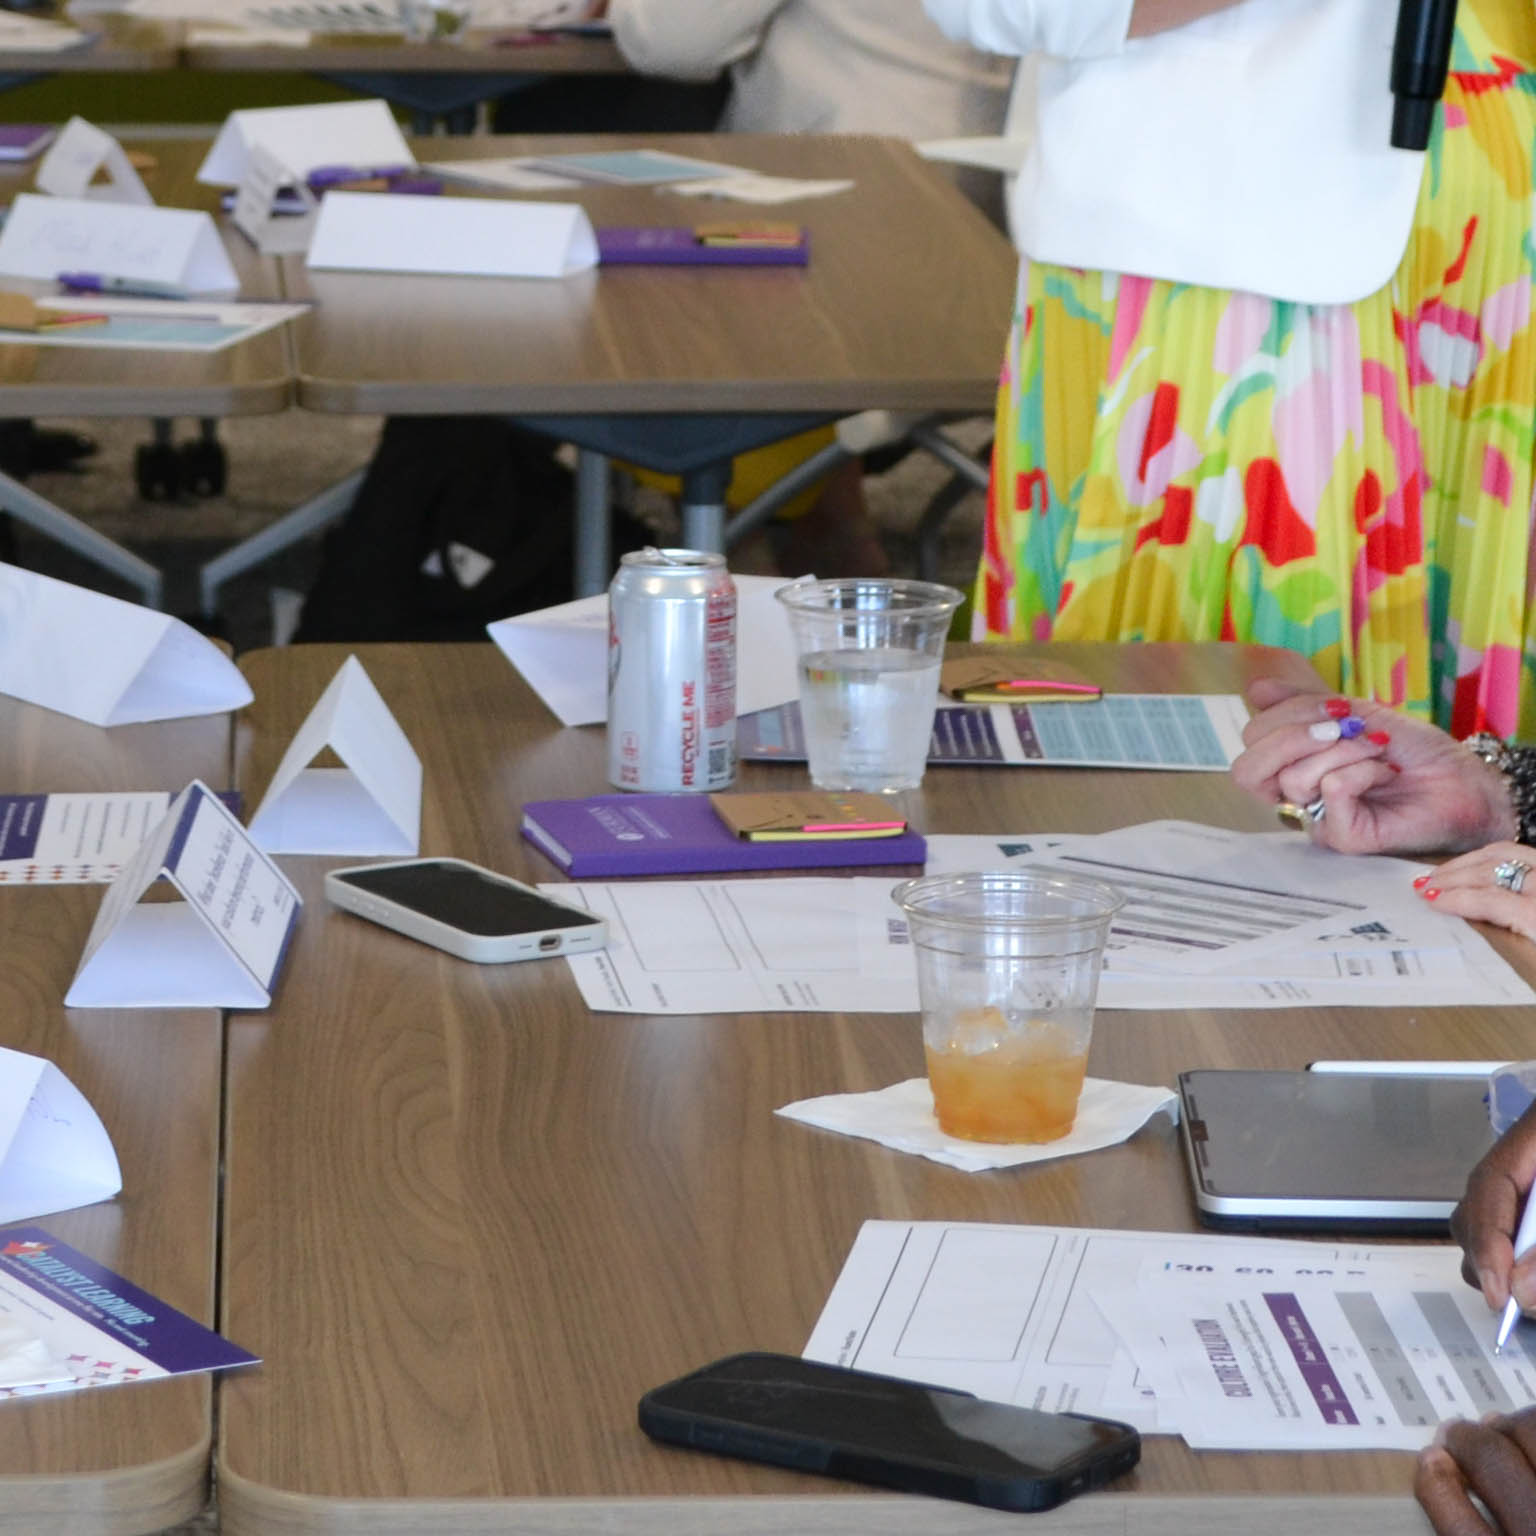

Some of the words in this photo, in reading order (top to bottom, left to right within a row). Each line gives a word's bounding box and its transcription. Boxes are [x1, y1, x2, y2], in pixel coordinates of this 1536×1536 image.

[681, 680, 696, 707] ME
[681, 712, 696, 787] RECYCLE
[15, 1250, 96, 1286] CATALYST
[72, 1284, 156, 1325] LEARNING
[1212, 1363, 1253, 1398] CULTURE
